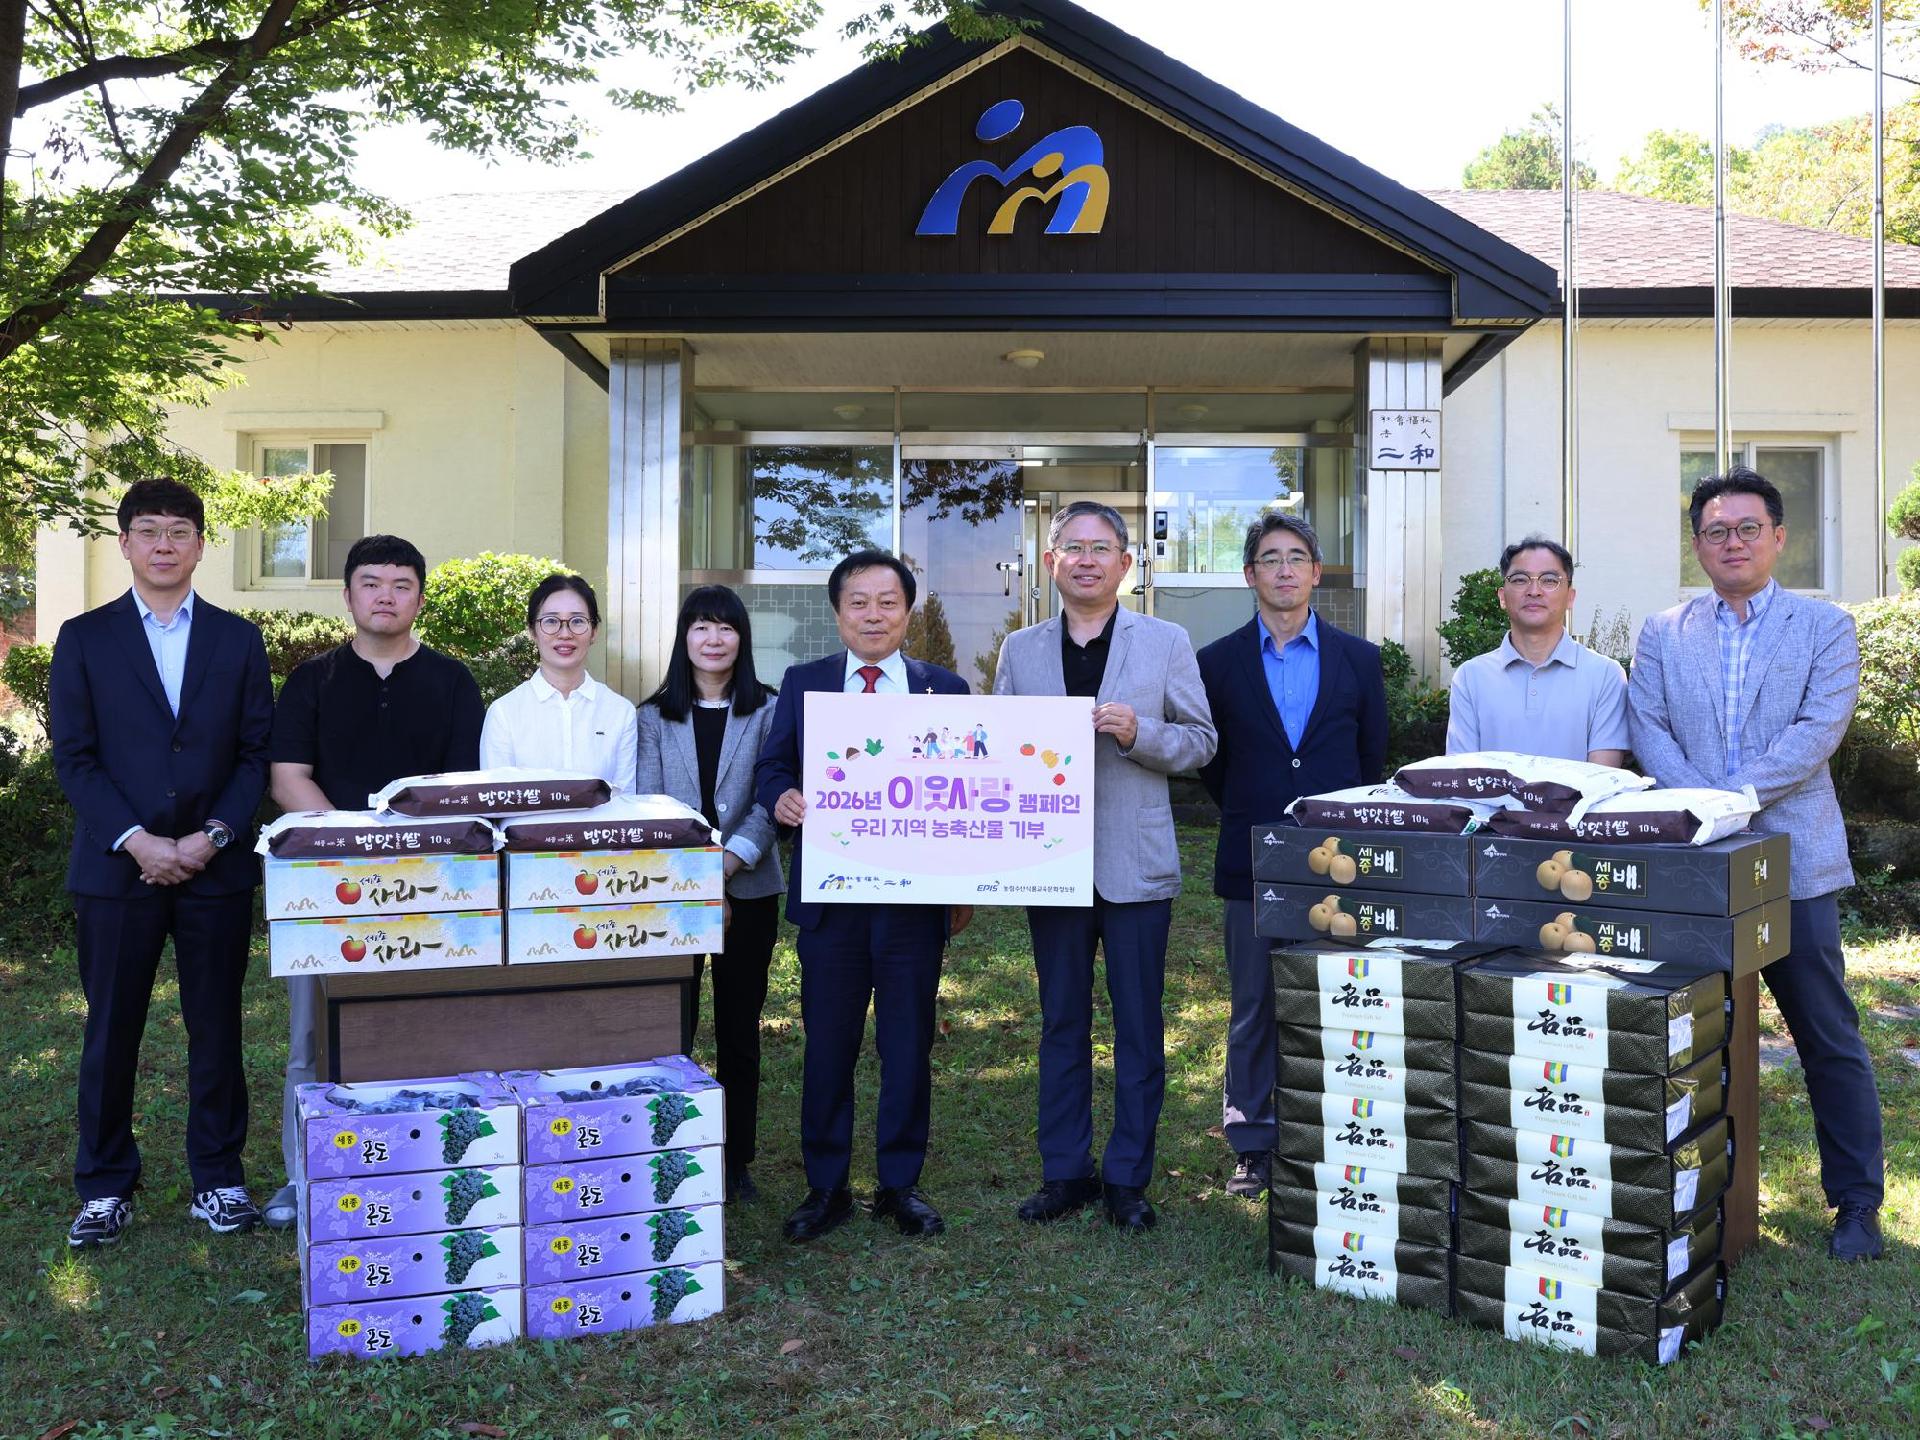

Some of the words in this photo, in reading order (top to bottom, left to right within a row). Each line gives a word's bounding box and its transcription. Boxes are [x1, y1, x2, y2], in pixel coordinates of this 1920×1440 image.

[1376, 443, 1435, 465] 二和
[815, 790, 882, 810] 2026년
[888, 775, 1014, 813] 이웃사랑
[1019, 793, 1080, 814] 캠페인
[1451, 779, 1459, 789] 米
[460, 795, 469, 804] 米
[1338, 810, 1346, 819] 米
[1549, 822, 1559, 831] 米
[336, 837, 346, 847] 米
[565, 833, 574, 843] 米
[851, 818, 886, 837] 우리
[891, 818, 926, 838] 지역
[931, 819, 1003, 839] 농축산물
[1009, 820, 1045, 840] 기부
[1358, 847, 1373, 874] 세종
[1374, 849, 1395, 874] 배
[605, 870, 669, 897] 사과
[976, 883, 999, 892] EPIS
[1595, 861, 1611, 891] 세종
[1613, 864, 1638, 890] 배
[369, 879, 439, 906] 사과
[1359, 904, 1373, 931] 세종
[1375, 908, 1395, 931] 배
[373, 936, 443, 963] 사과
[604, 924, 668, 950] 사과
[1598, 923, 1614, 952] 세종
[1616, 927, 1641, 954] 배
[1331, 982, 1384, 1008] 名品
[1527, 1008, 1587, 1036] 名品
[1335, 1052, 1387, 1078] 名品
[1523, 1086, 1583, 1114] 名品
[553, 1121, 569, 1131] 세종
[577, 1126, 602, 1149] 포도
[1335, 1121, 1388, 1147] 名品
[337, 1135, 354, 1144] 세종
[362, 1139, 390, 1165] 포도
[1530, 1159, 1591, 1189] 名品
[555, 1181, 570, 1190] 세종
[579, 1185, 604, 1208] 포도
[1328, 1186, 1381, 1213] 名品
[341, 1198, 358, 1208] 세종
[366, 1203, 393, 1227] 포도
[553, 1239, 569, 1249] 세종
[577, 1244, 602, 1267] 포도
[1523, 1229, 1583, 1259] 名品
[341, 1259, 358, 1269] 세종
[366, 1263, 393, 1287] 포도
[1327, 1253, 1379, 1280] 名品
[554, 1300, 569, 1310] 세종
[578, 1304, 602, 1327] 포도
[1517, 1301, 1576, 1333] 名品
[341, 1322, 358, 1333] 세종
[366, 1328, 393, 1352] 포도
